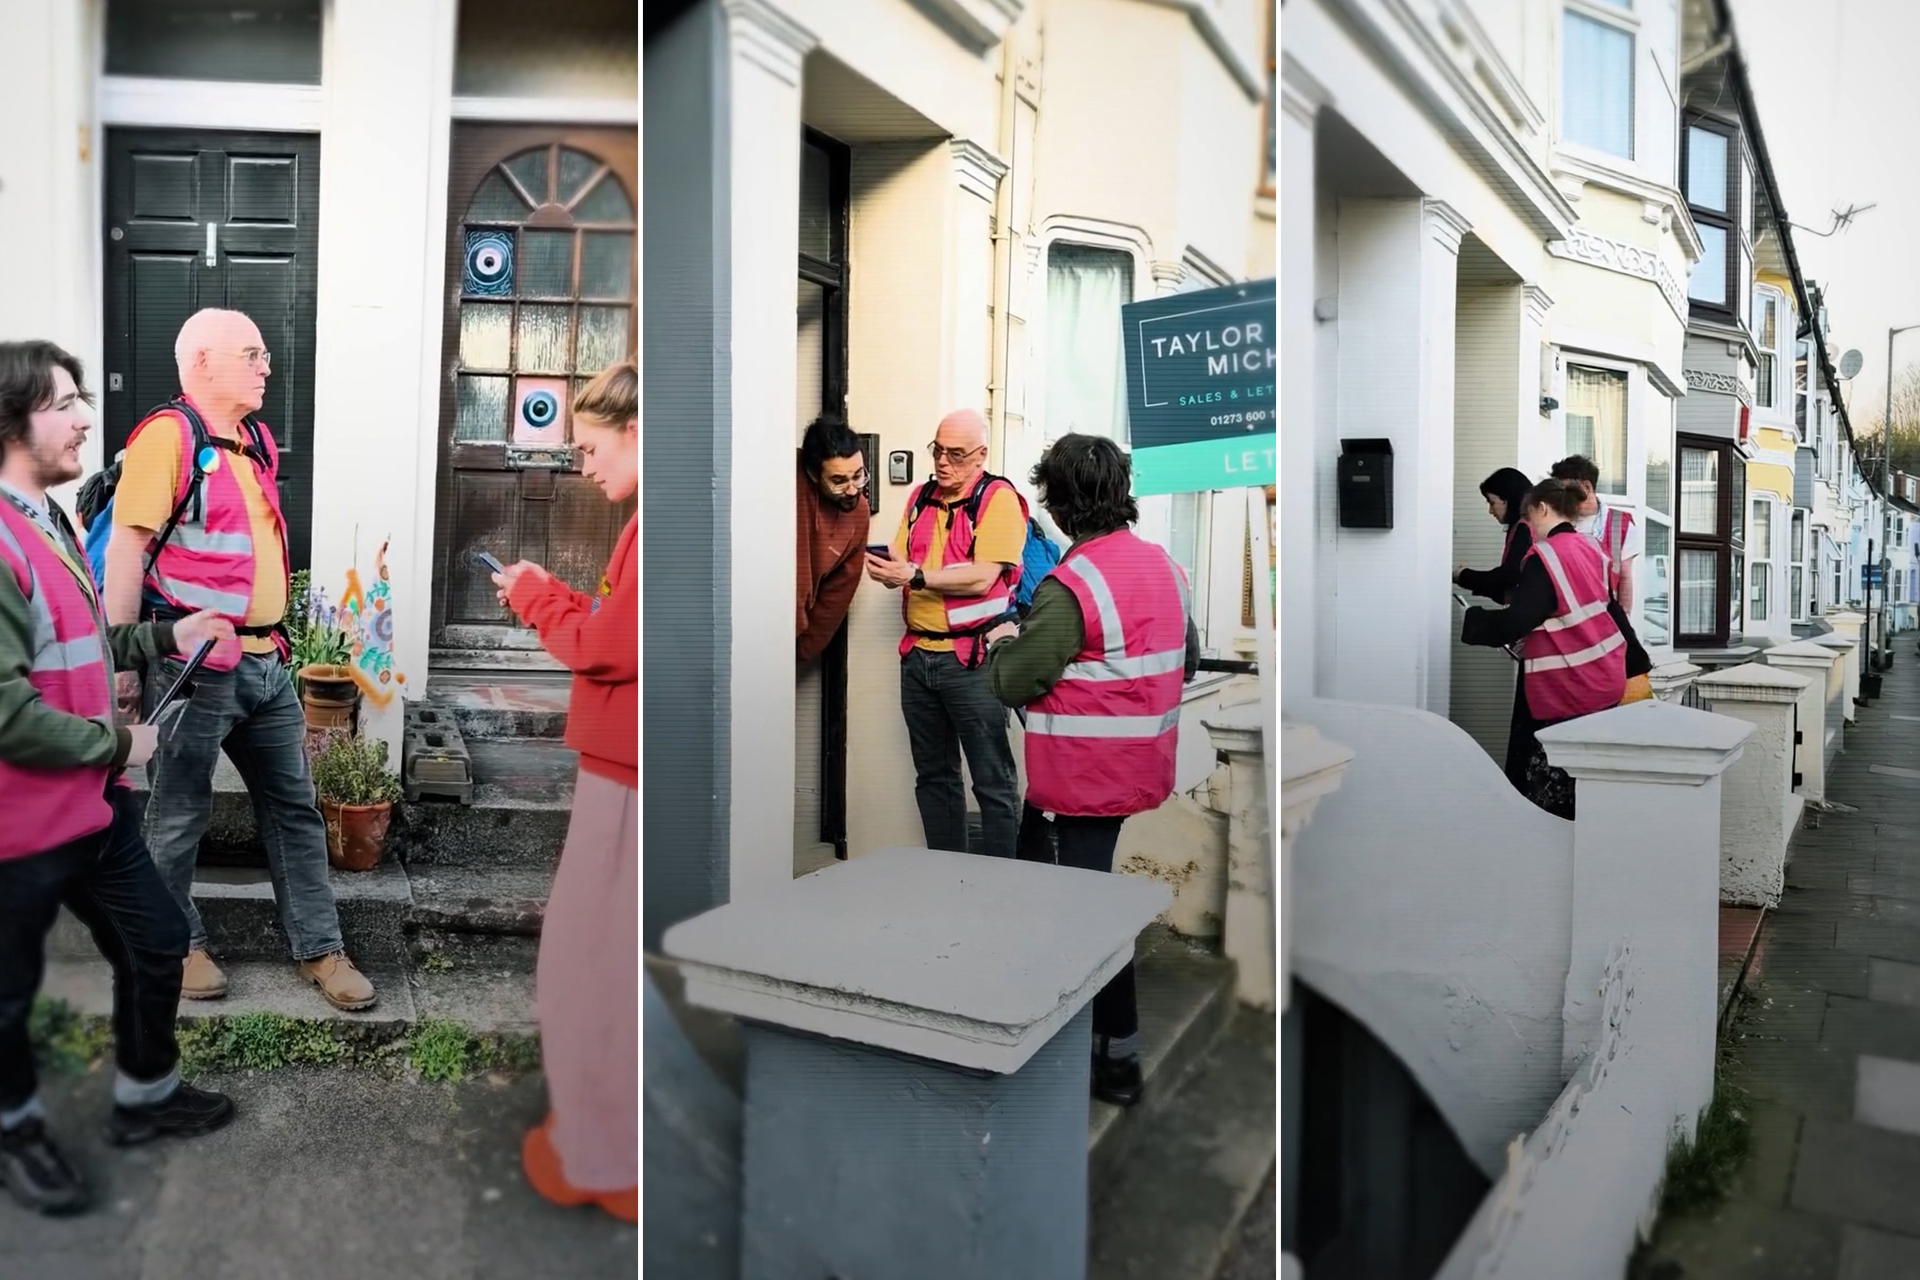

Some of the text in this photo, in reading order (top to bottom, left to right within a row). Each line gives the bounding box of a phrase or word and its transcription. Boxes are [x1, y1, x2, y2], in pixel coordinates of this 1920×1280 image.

[1151, 323, 1263, 358] TAYLOR
[1179, 385, 1274, 406] SALES & LET
[1210, 413, 1243, 426] 01273
[1245, 410, 1266, 422] 600
[1224, 449, 1276, 473] LET
